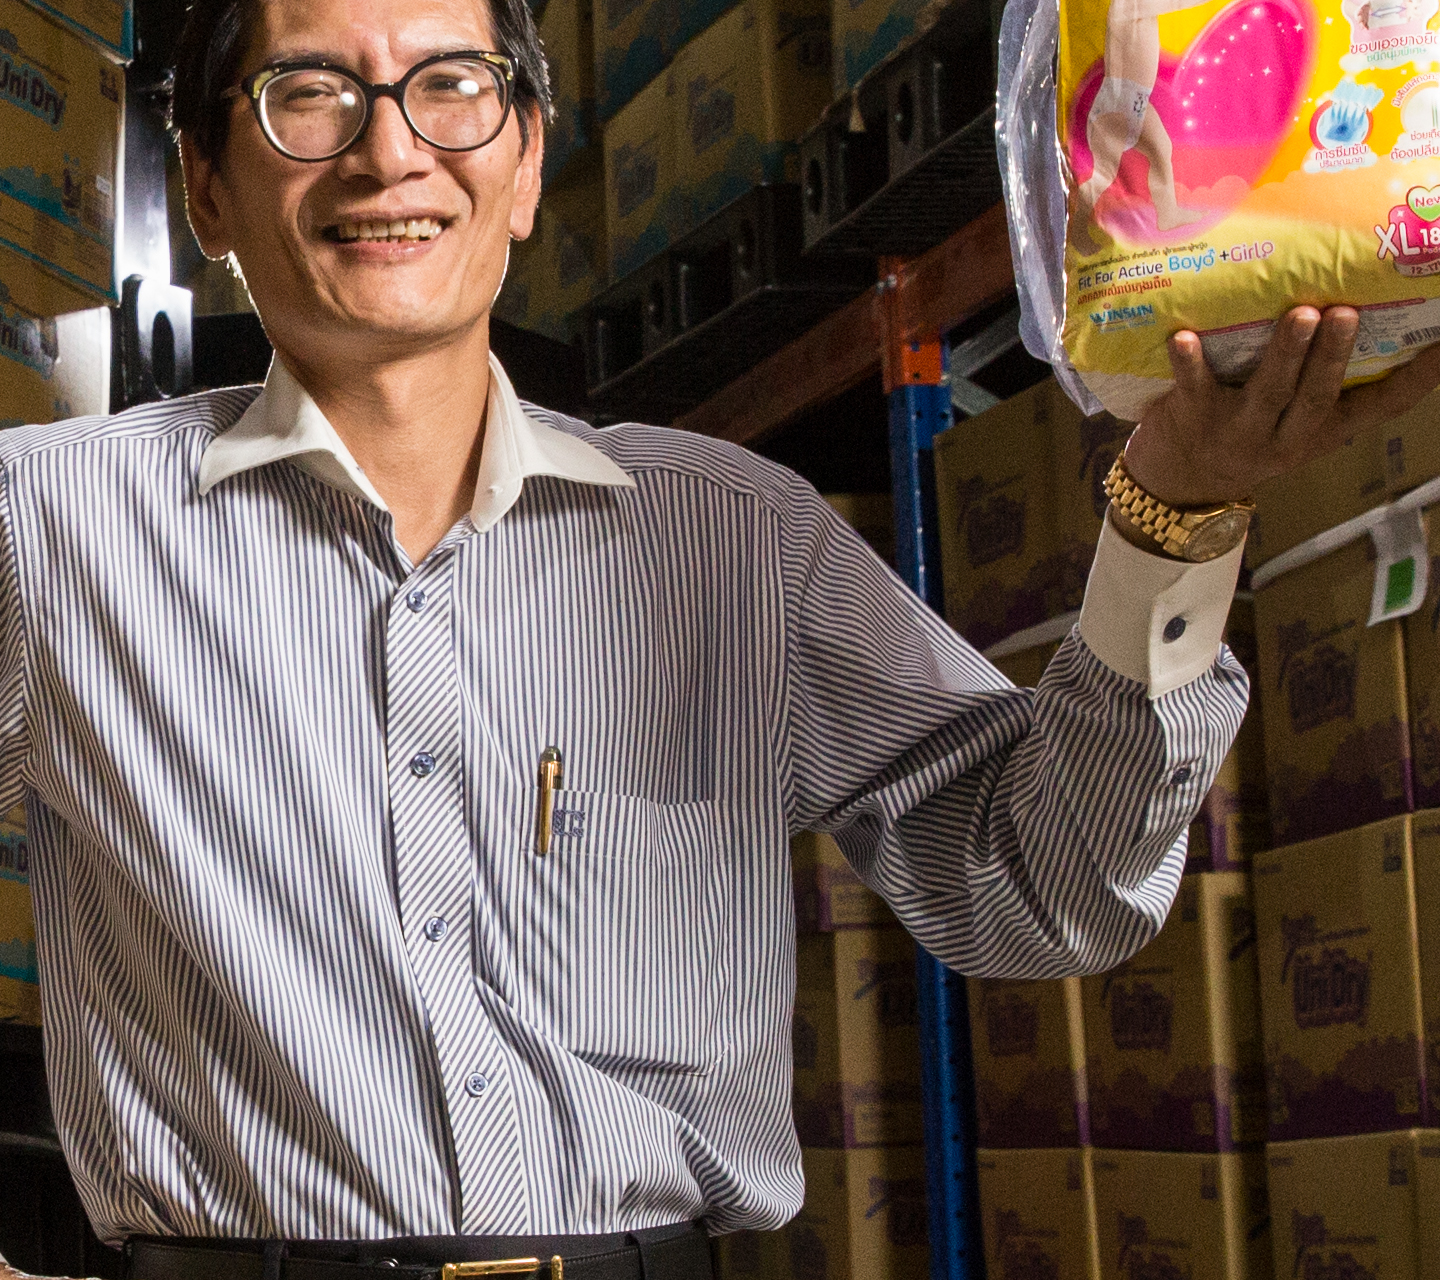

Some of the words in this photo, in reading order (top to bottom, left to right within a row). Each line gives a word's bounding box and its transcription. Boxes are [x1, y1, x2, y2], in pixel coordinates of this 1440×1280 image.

[1375, 222, 1420, 259] XL
[1078, 277, 1091, 291] Fit
[1095, 271, 1114, 284] For
[1118, 263, 1163, 280] Active
[1090, 304, 1153, 324] WINSUN
